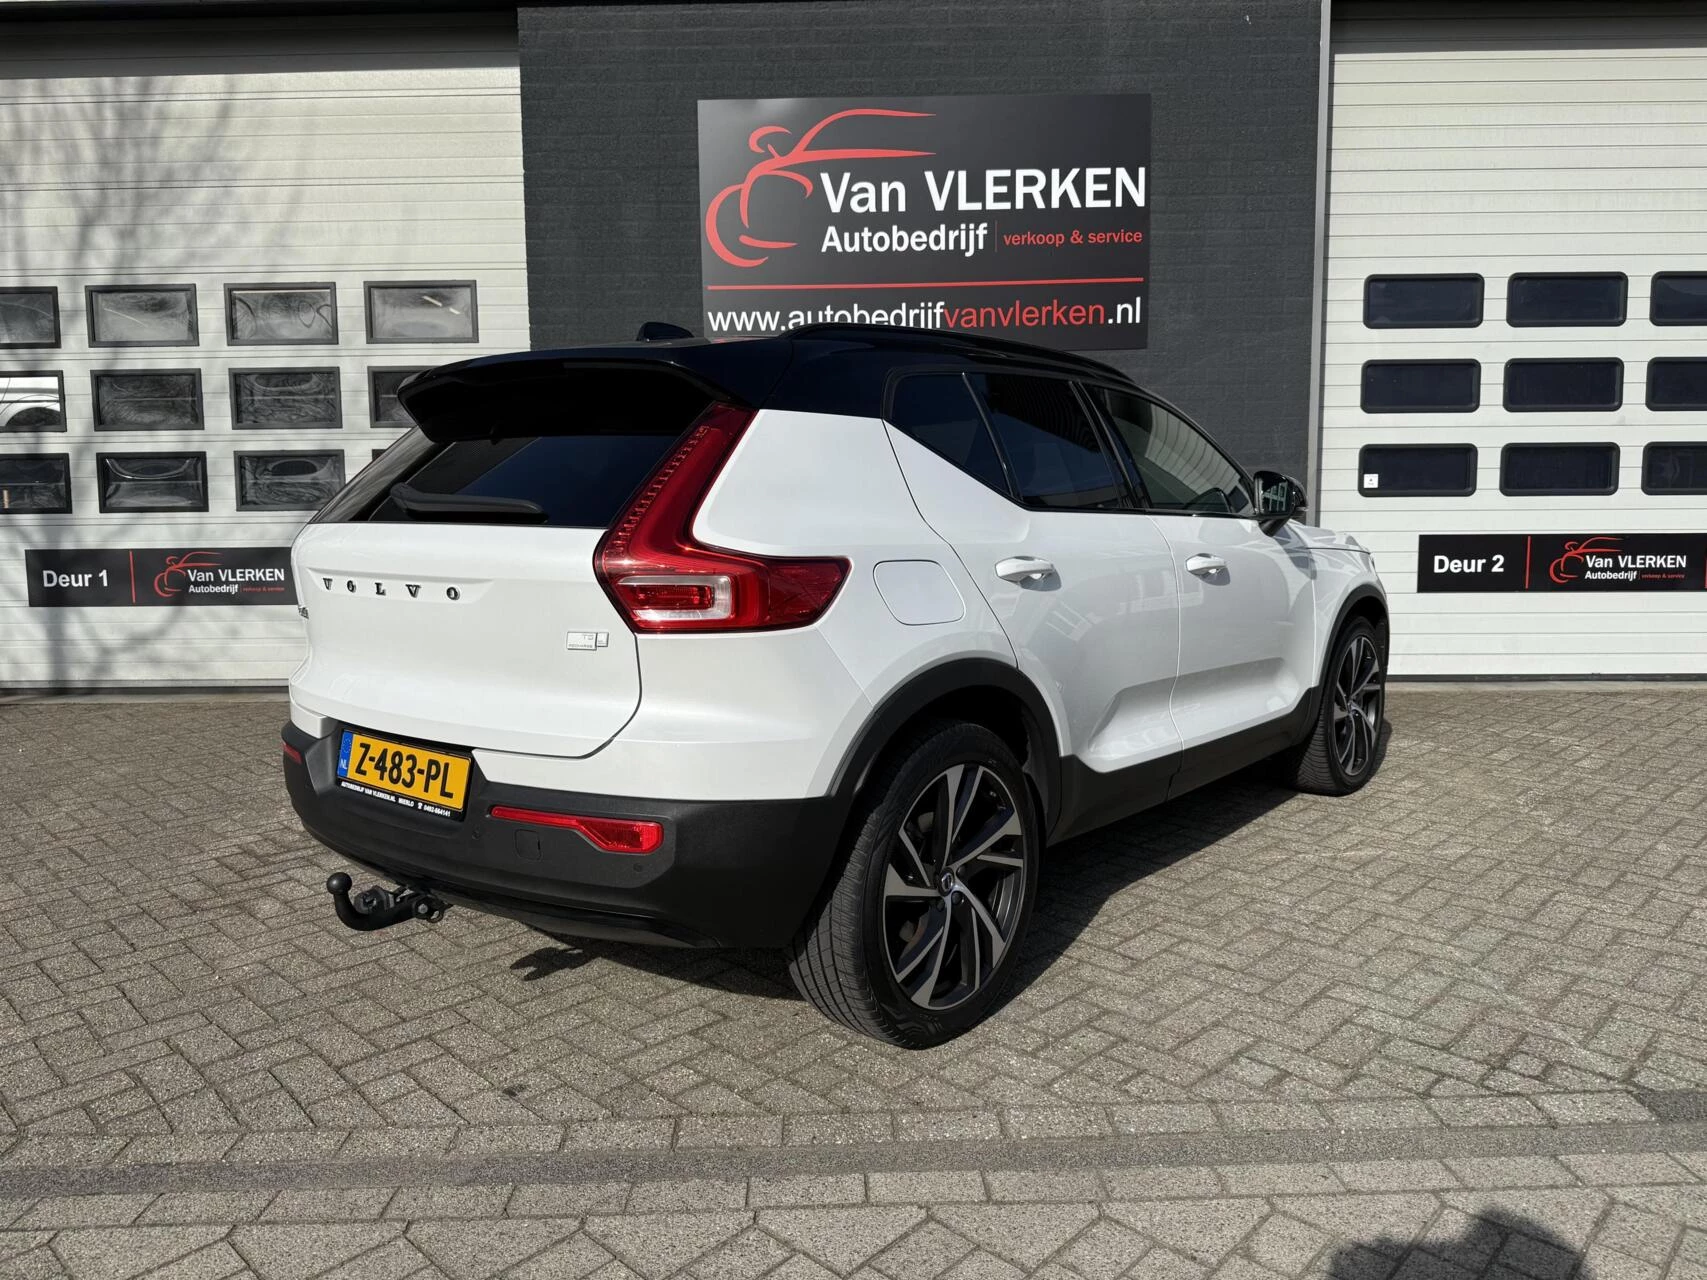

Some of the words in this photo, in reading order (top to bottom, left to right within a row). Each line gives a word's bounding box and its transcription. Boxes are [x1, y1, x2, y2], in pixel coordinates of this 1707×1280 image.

[820, 172, 906, 213] Van
[924, 166, 1147, 212] VLERKEN
[820, 222, 989, 257] Autobedrijf
[1003, 231, 1066, 248] verkoop
[1070, 229, 1084, 244] &
[1088, 228, 1144, 244] service
[707, 296, 1142, 333] www.autobedrijfvanvlerken.nl
[1433, 555, 1486, 573] Deur
[1491, 554, 1505, 573] 2
[1585, 555, 1613, 568] Van
[1618, 555, 1687, 568] VLERKEN
[42, 570, 93, 588] Deur
[99, 569, 108, 587] 1
[187, 569, 214, 582] Van
[218, 568, 285, 581] VLERKEN
[1584, 570, 1638, 581] Autobedrijf
[188, 584, 239, 594] Autobedrijf
[322, 577, 461, 601] VOLVO
[338, 758, 348, 770] NL
[354, 742, 454, 799] Z-483-PL
